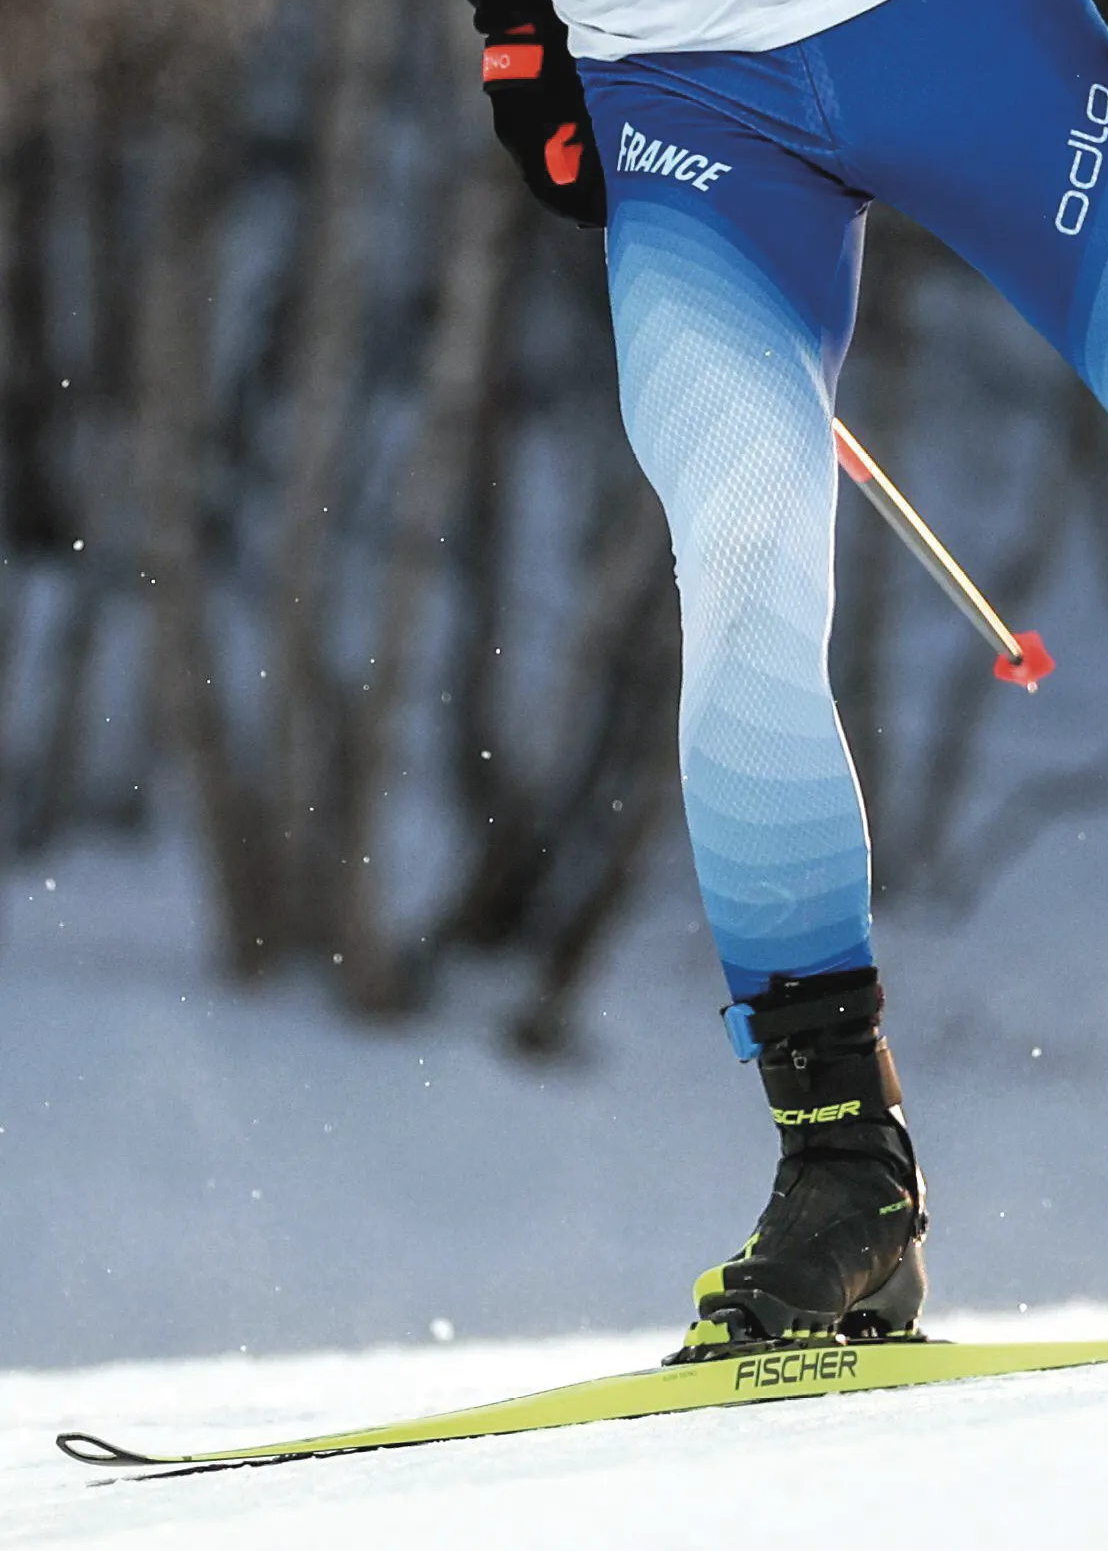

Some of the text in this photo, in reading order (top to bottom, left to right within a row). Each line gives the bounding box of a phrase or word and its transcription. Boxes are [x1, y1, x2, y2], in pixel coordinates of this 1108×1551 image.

[616, 121, 733, 192] FRANCE
[770, 1099, 861, 1125] SCHER
[734, 1350, 858, 1391] FISCHER
